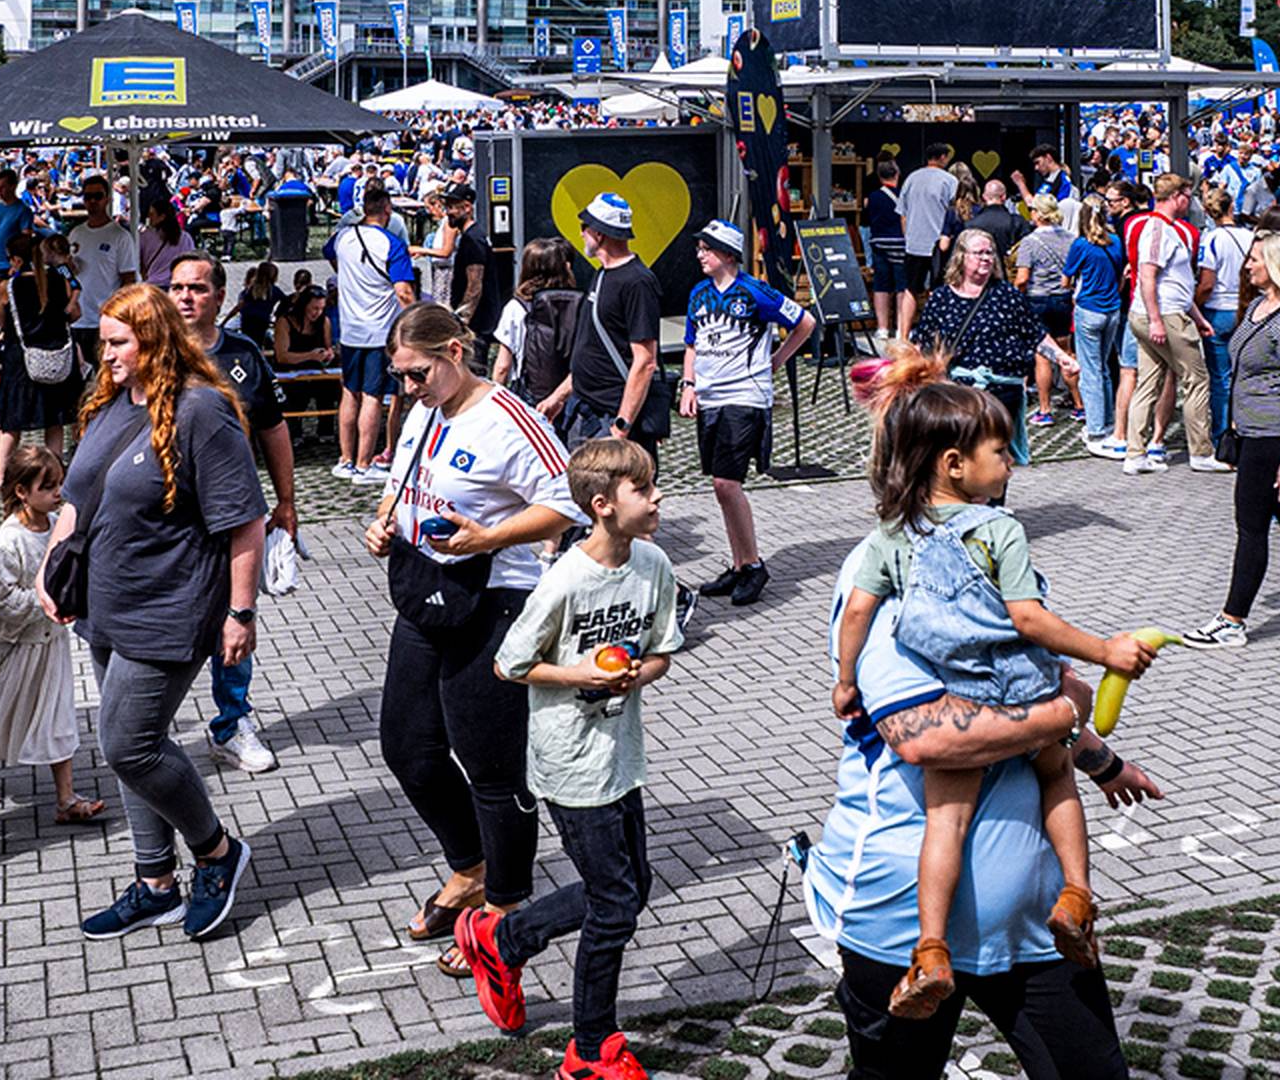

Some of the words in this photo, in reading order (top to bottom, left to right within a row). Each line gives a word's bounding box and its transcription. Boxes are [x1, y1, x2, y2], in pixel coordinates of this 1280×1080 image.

[9, 120, 54, 136] Wir
[103, 115, 267, 131] Lebensmittel.
[571, 601, 631, 635] FAST
[577, 611, 657, 654] FURIOS
